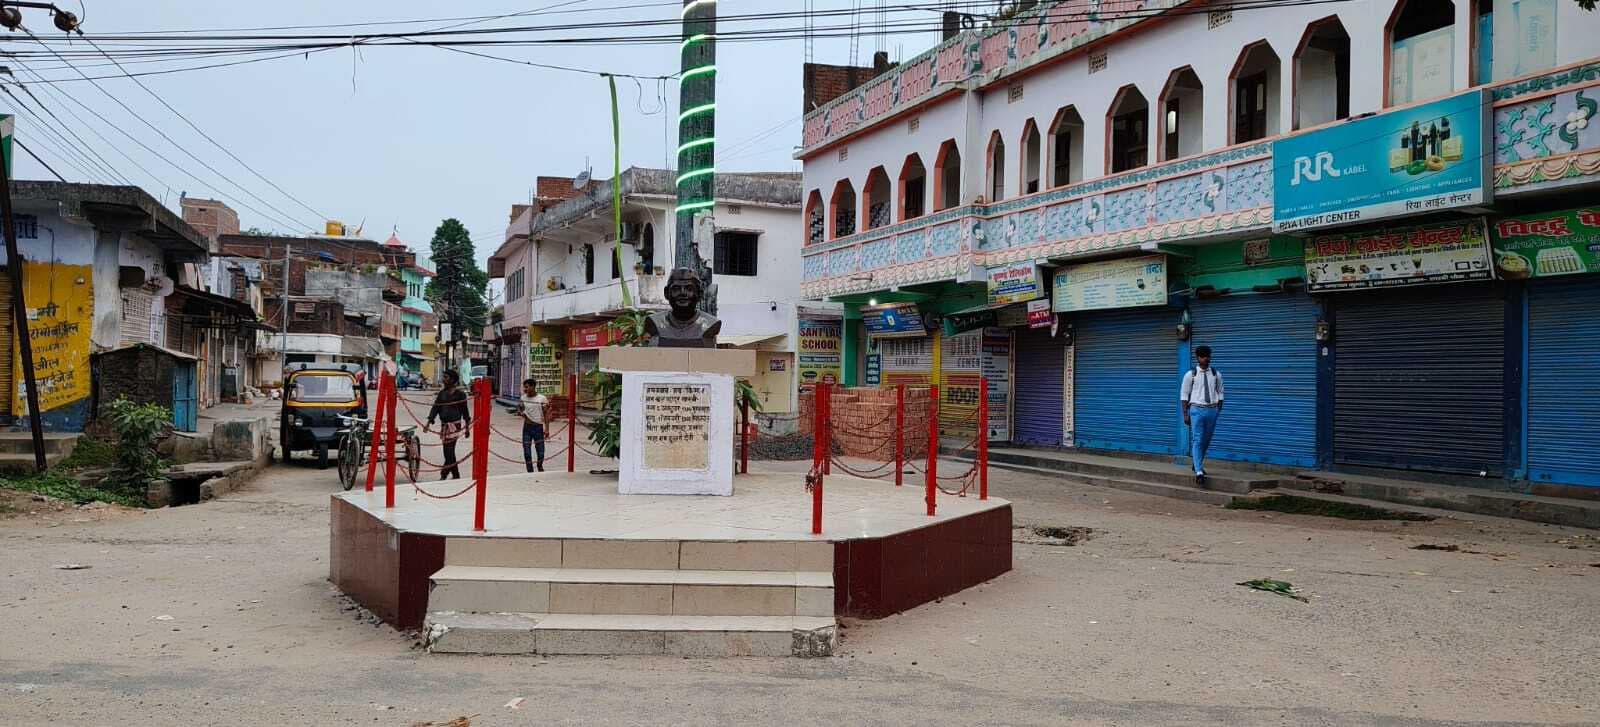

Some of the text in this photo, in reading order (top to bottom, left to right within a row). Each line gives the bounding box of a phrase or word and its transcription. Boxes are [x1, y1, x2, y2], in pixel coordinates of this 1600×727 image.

[1290, 151, 1341, 186] RR
[1406, 199, 1422, 211] रिया
[1449, 192, 1472, 205] सेन्टर
[1279, 210, 1361, 230] RIYA LIGHT CENTER
[1316, 236, 1349, 256] रिया
[801, 338, 837, 350] SCHOOL
